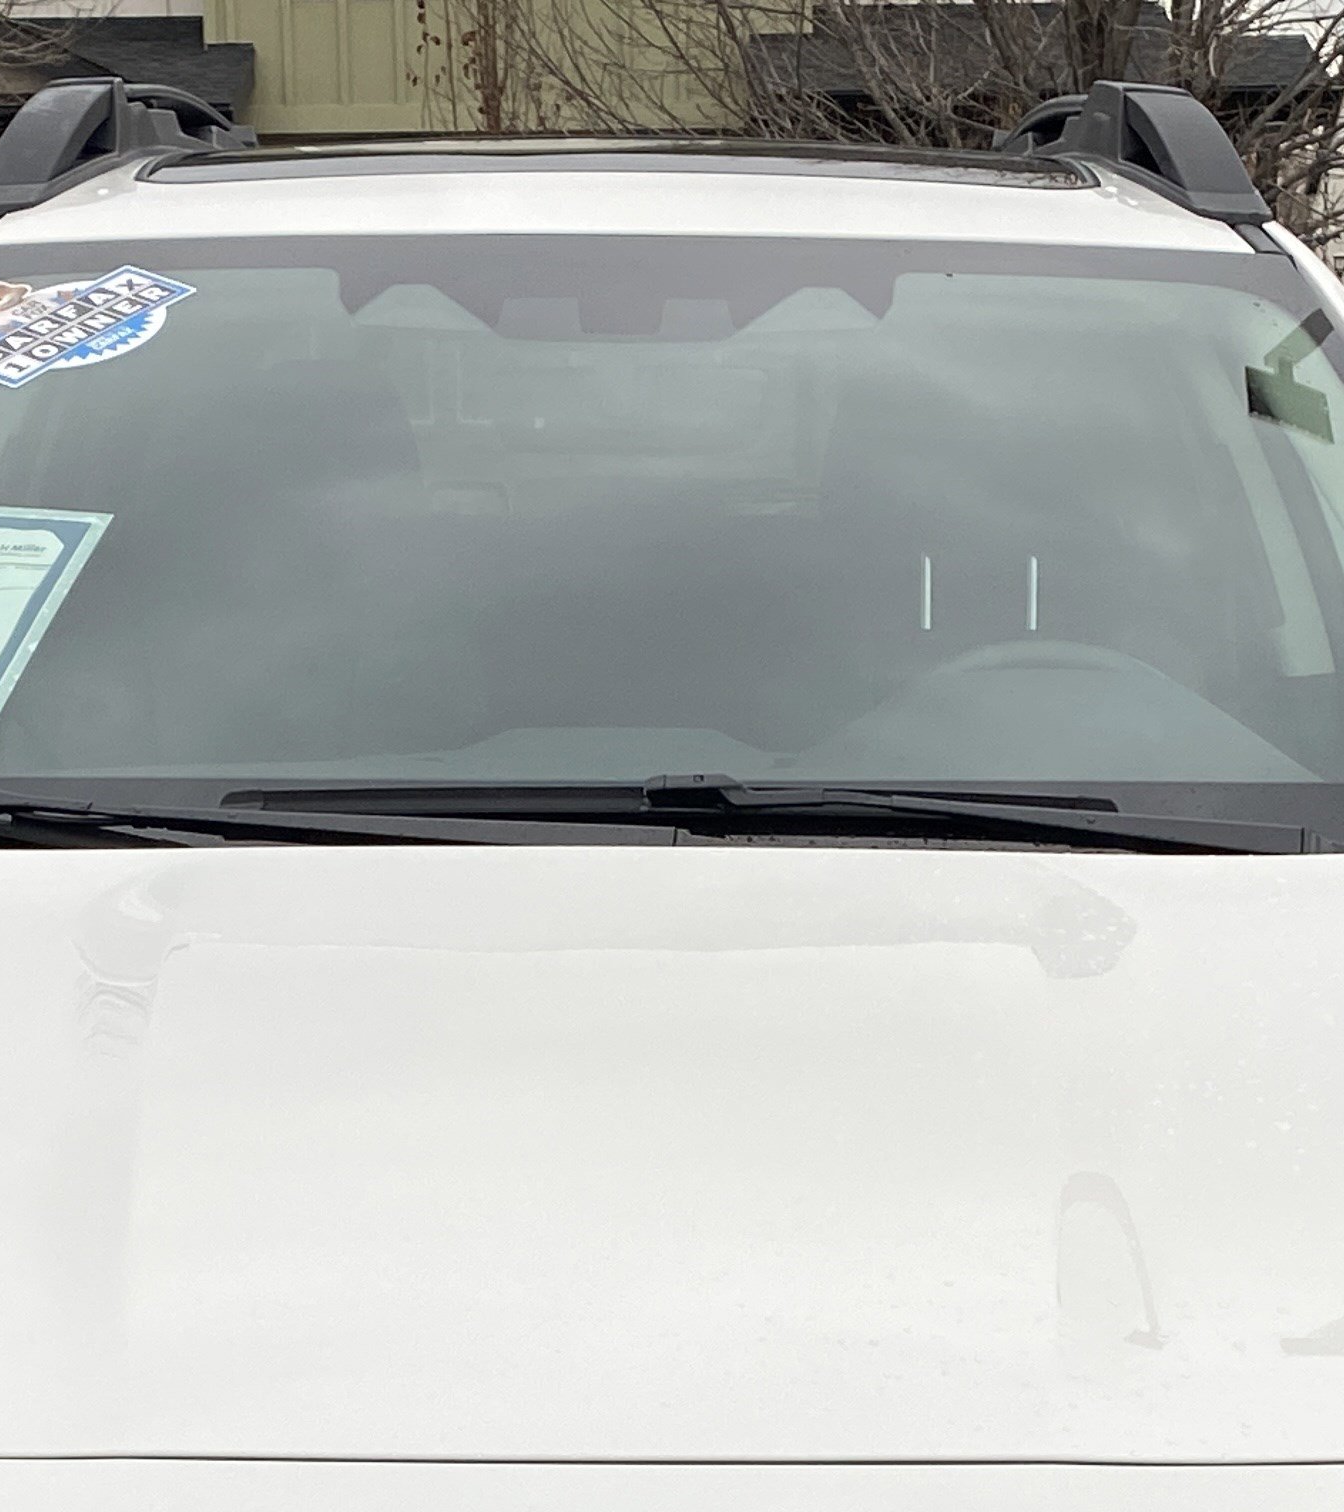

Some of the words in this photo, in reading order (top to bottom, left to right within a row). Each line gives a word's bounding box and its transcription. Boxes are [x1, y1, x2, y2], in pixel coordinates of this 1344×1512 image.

[3, 361, 31, 373] 1
[31, 286, 170, 358] OWNER
[10, 544, 47, 552] Miller
